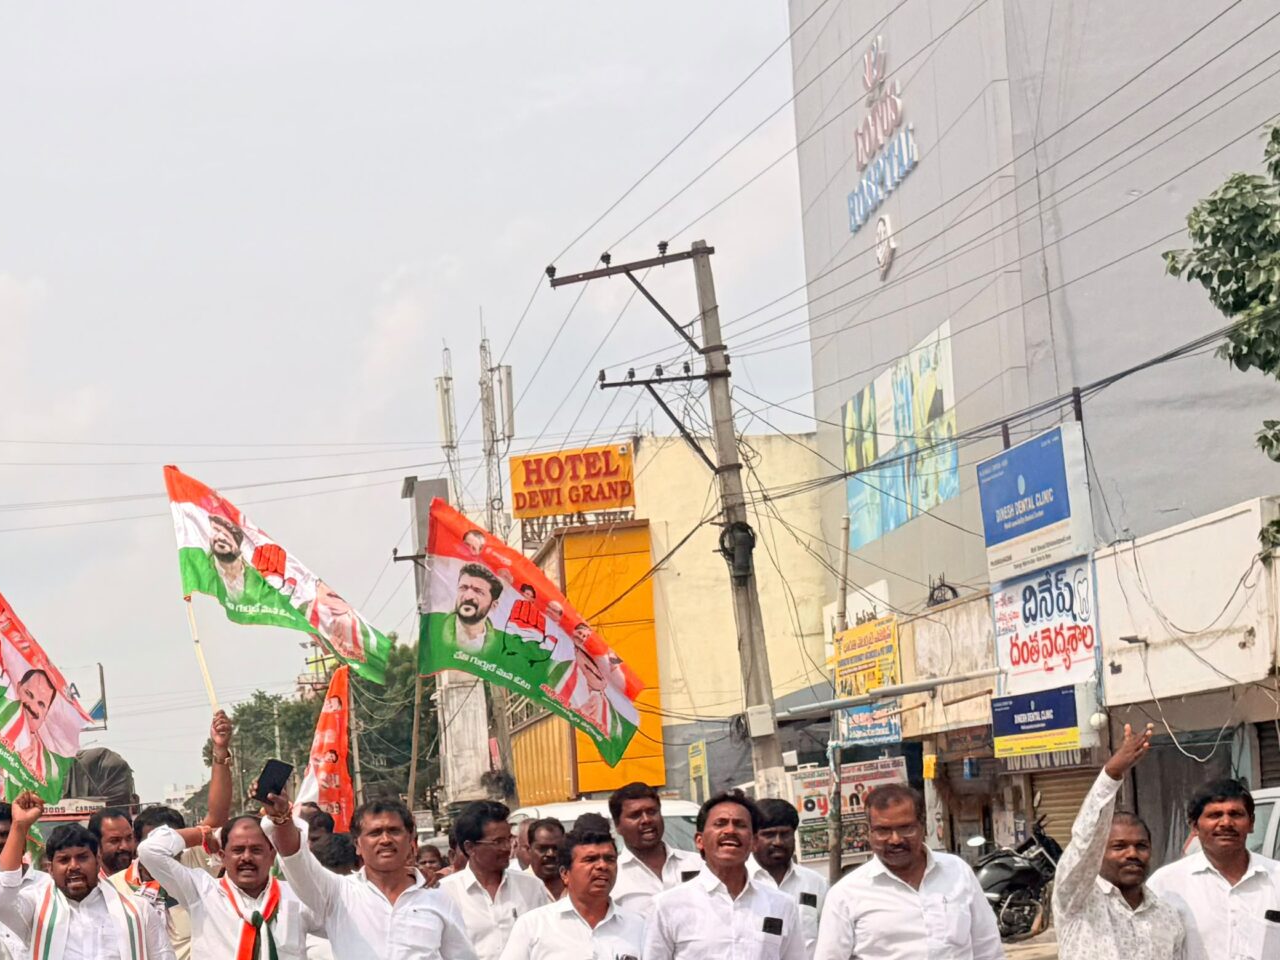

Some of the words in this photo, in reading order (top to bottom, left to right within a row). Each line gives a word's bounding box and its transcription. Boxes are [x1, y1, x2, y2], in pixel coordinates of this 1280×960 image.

[522, 450, 620, 486] HOTEL
[568, 480, 631, 504] GRAND
[1035, 488, 1054, 508] CLINIC
